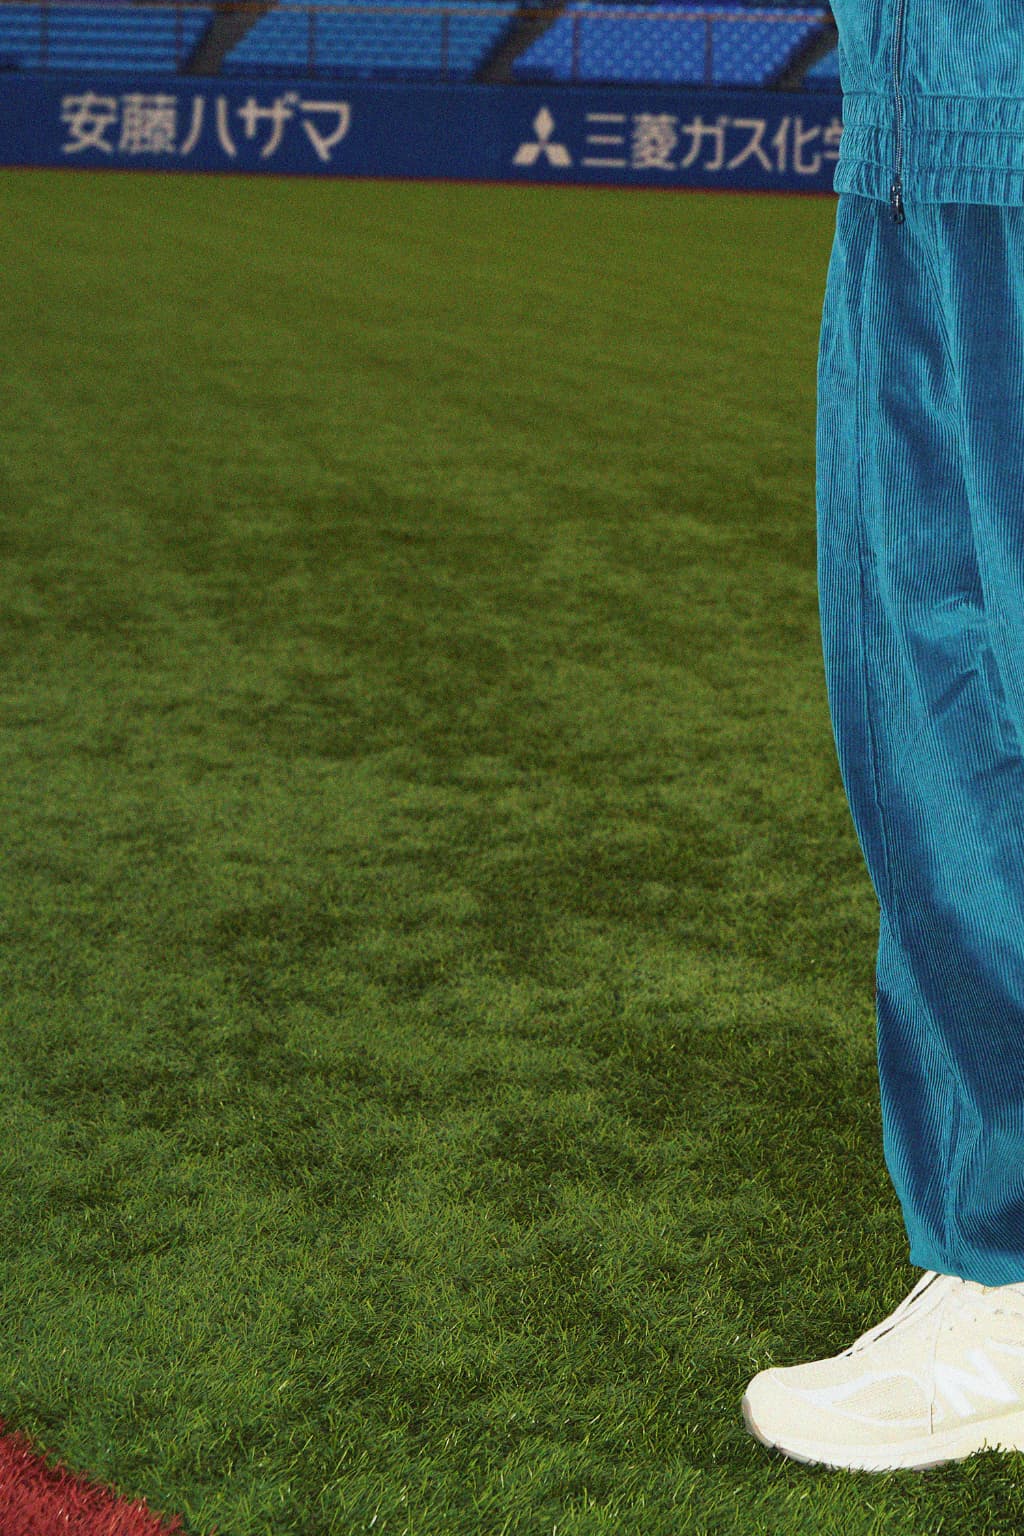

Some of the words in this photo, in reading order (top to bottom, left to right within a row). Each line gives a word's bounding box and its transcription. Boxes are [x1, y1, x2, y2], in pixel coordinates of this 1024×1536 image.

[60, 91, 351, 161] 安藤ハザマ
